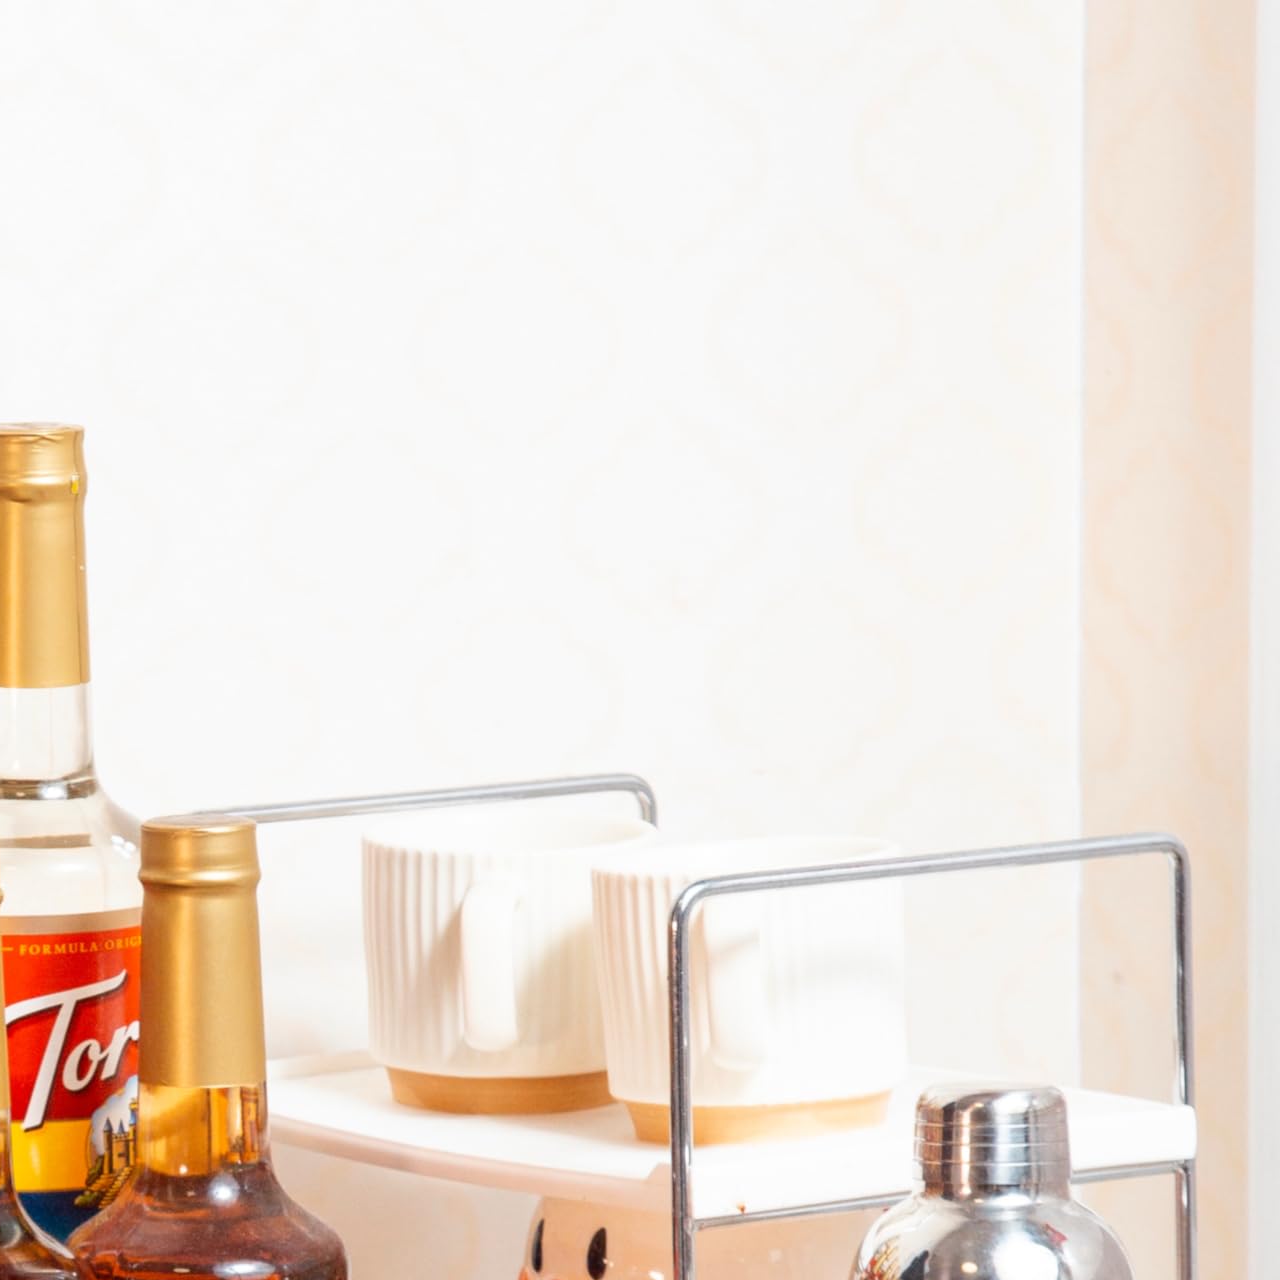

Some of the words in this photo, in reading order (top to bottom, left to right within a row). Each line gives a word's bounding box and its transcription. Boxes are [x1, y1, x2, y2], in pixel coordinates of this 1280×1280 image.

[19, 942, 98, 956] FORMULA
[104, 934, 142, 951] ORIGI
[4, 969, 140, 1131] Tor
